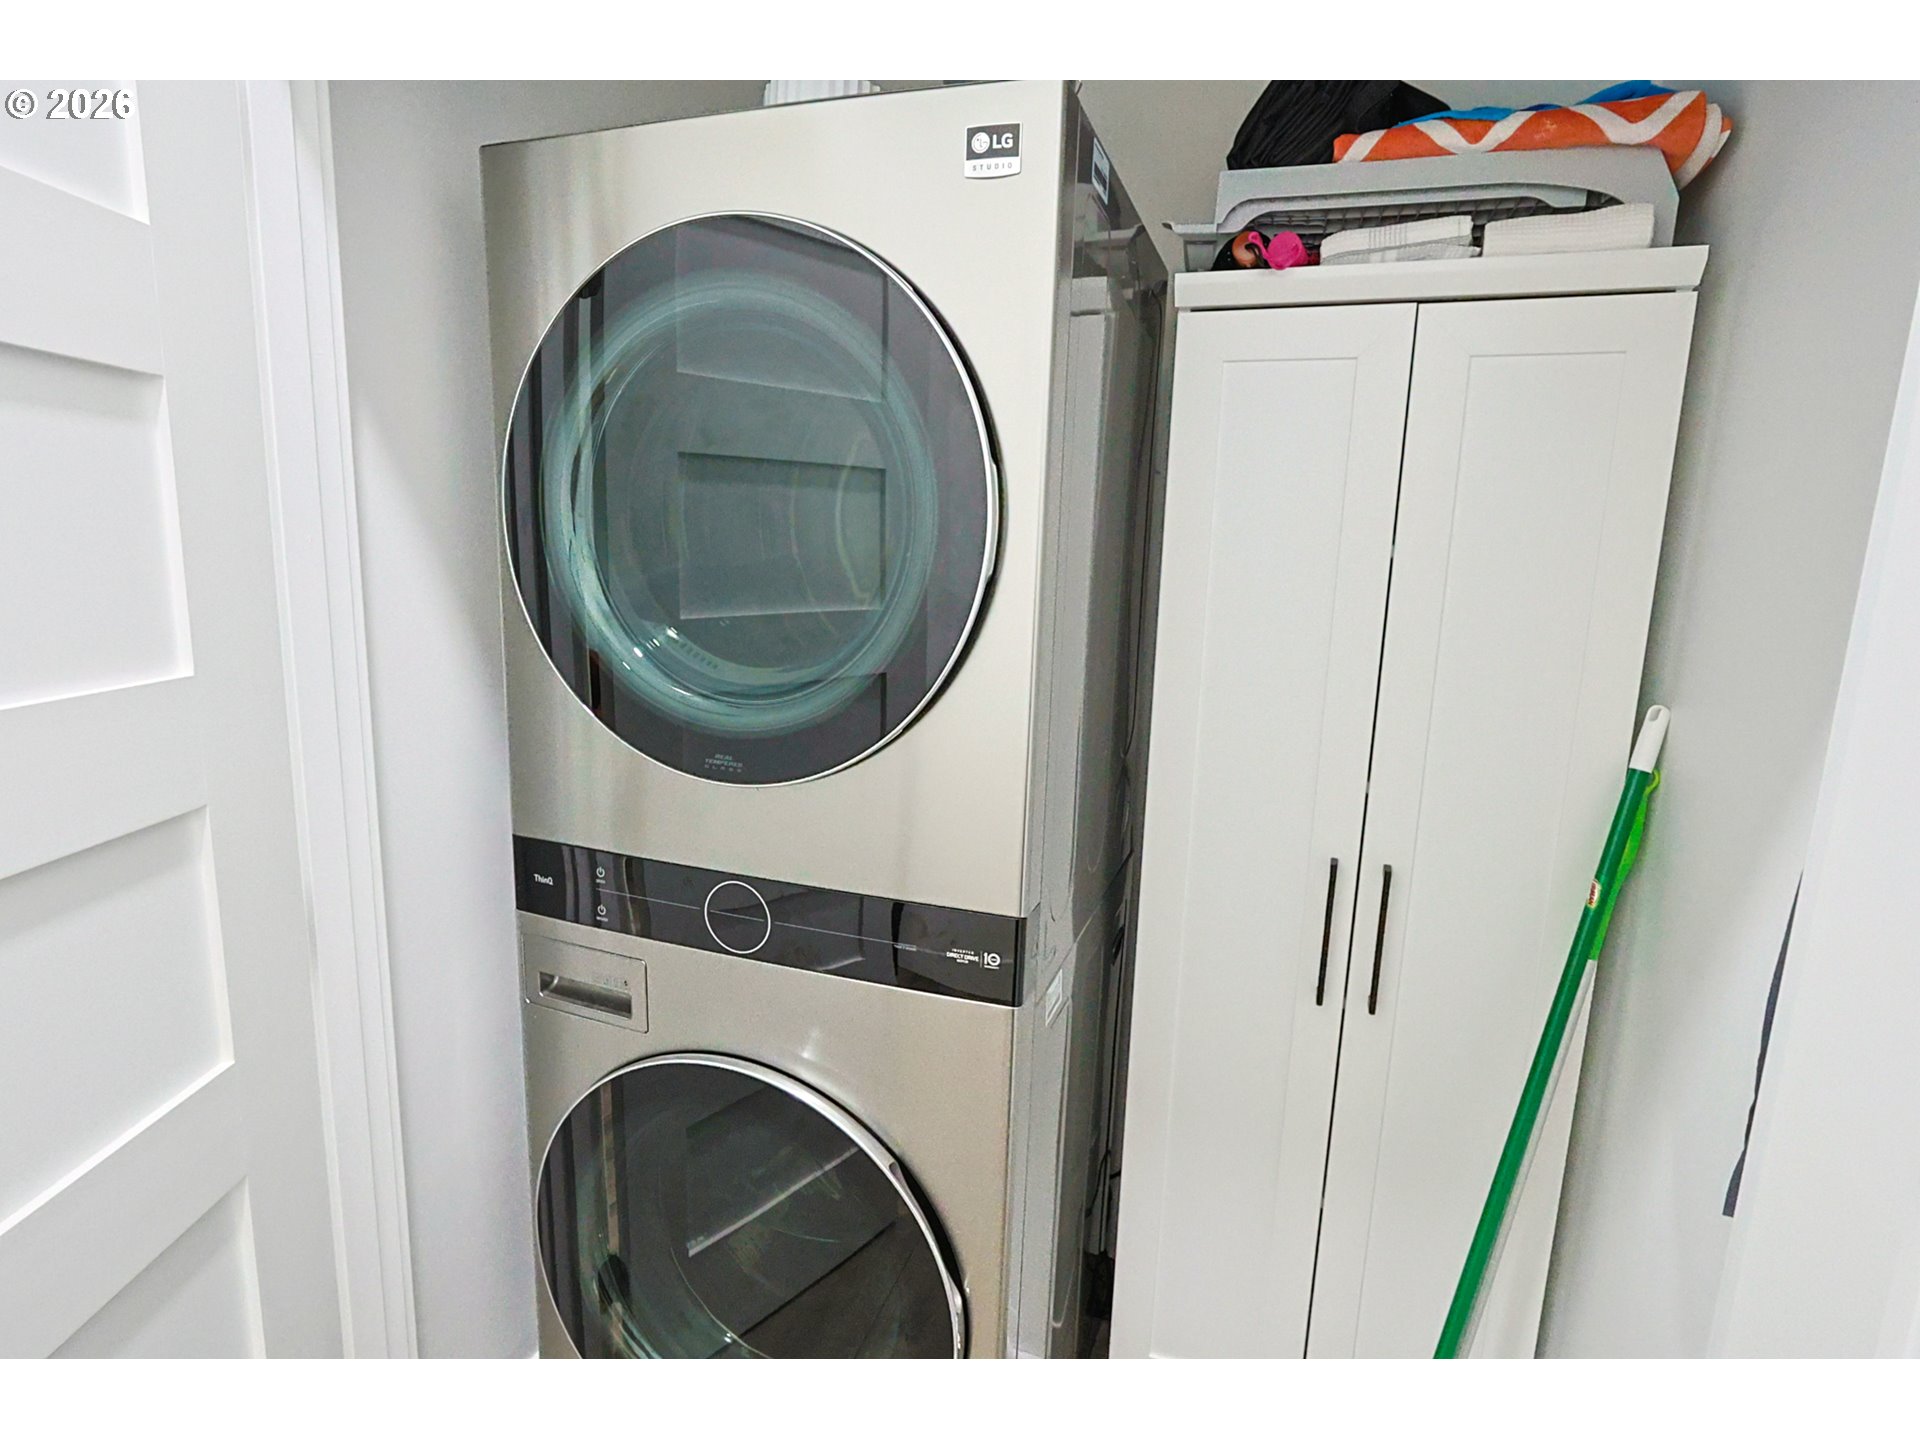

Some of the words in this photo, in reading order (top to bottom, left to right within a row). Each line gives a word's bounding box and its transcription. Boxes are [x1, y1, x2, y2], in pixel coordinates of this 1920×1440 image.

[992, 132, 1014, 149] LG
[972, 162, 1013, 171] STUDIO
[533, 873, 554, 886] ThinQ
[946, 951, 964, 960] DIRECT
[963, 954, 980, 962] DRIVE
